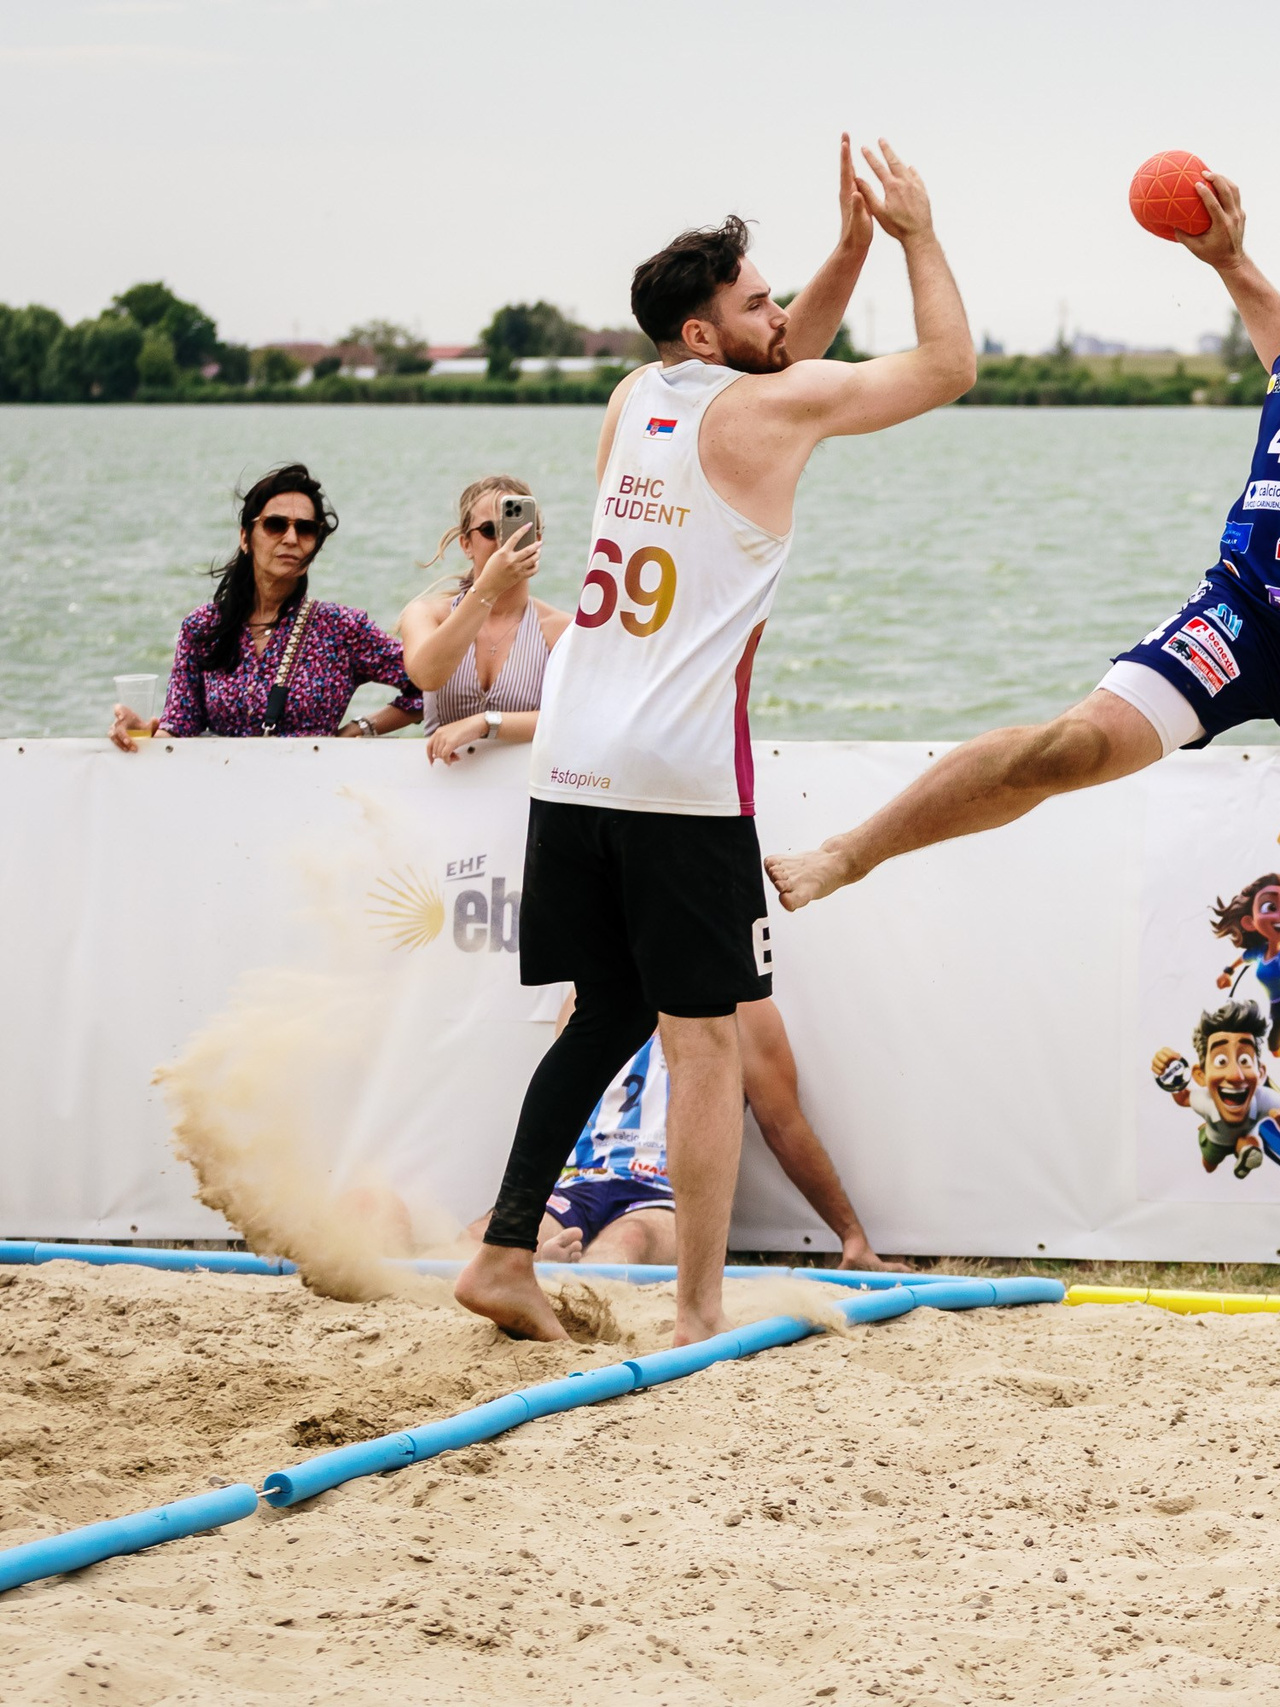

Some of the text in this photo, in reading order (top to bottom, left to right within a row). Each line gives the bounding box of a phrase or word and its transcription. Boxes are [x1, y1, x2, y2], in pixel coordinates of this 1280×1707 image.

[619, 475, 664, 498] BHC
[601, 497, 690, 527] TUDENT
[575, 538, 677, 638] 69
[551, 767, 611, 789] #stopiva
[446, 854, 487, 877] EHF
[453, 877, 521, 953] eb
[618, 1074, 646, 1113] 2
